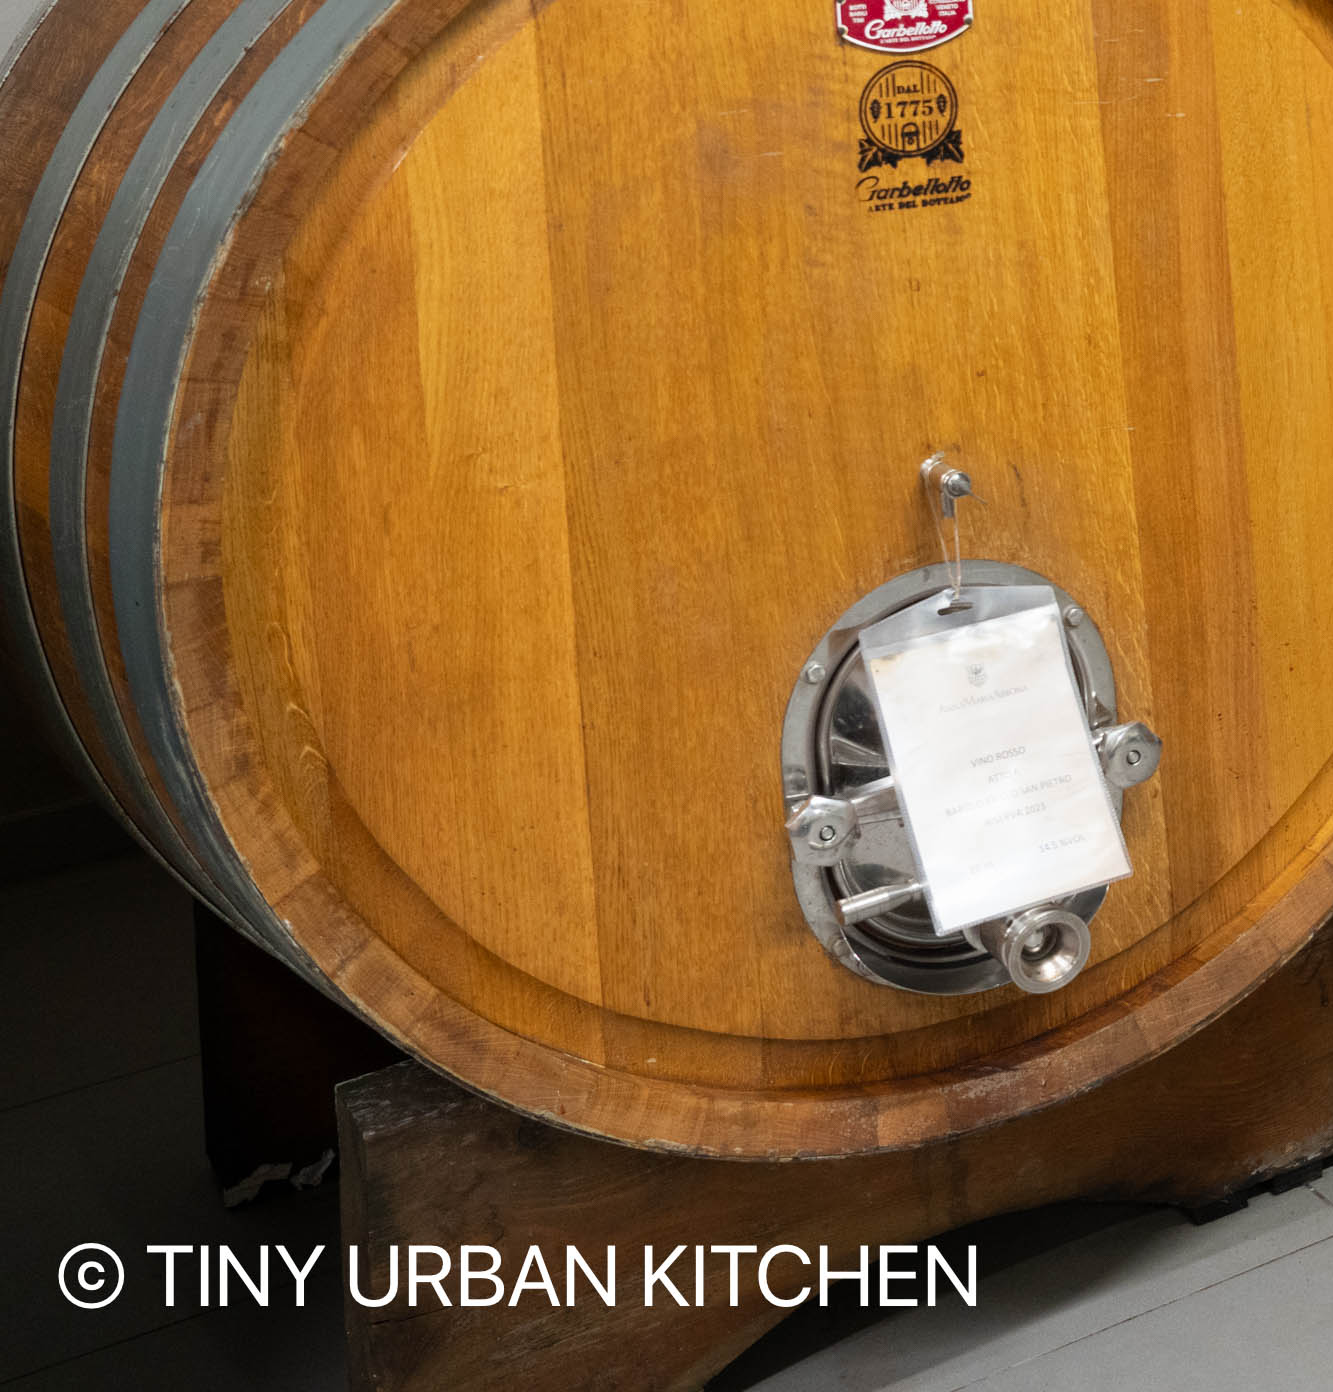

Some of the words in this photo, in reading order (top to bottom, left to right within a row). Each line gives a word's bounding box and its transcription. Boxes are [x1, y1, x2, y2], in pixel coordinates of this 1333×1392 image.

[896, 84, 920, 95] DAL
[885, 100, 934, 119] 1775
[898, 199, 918, 210] DEL
[996, 746, 1027, 761] ROSSO
